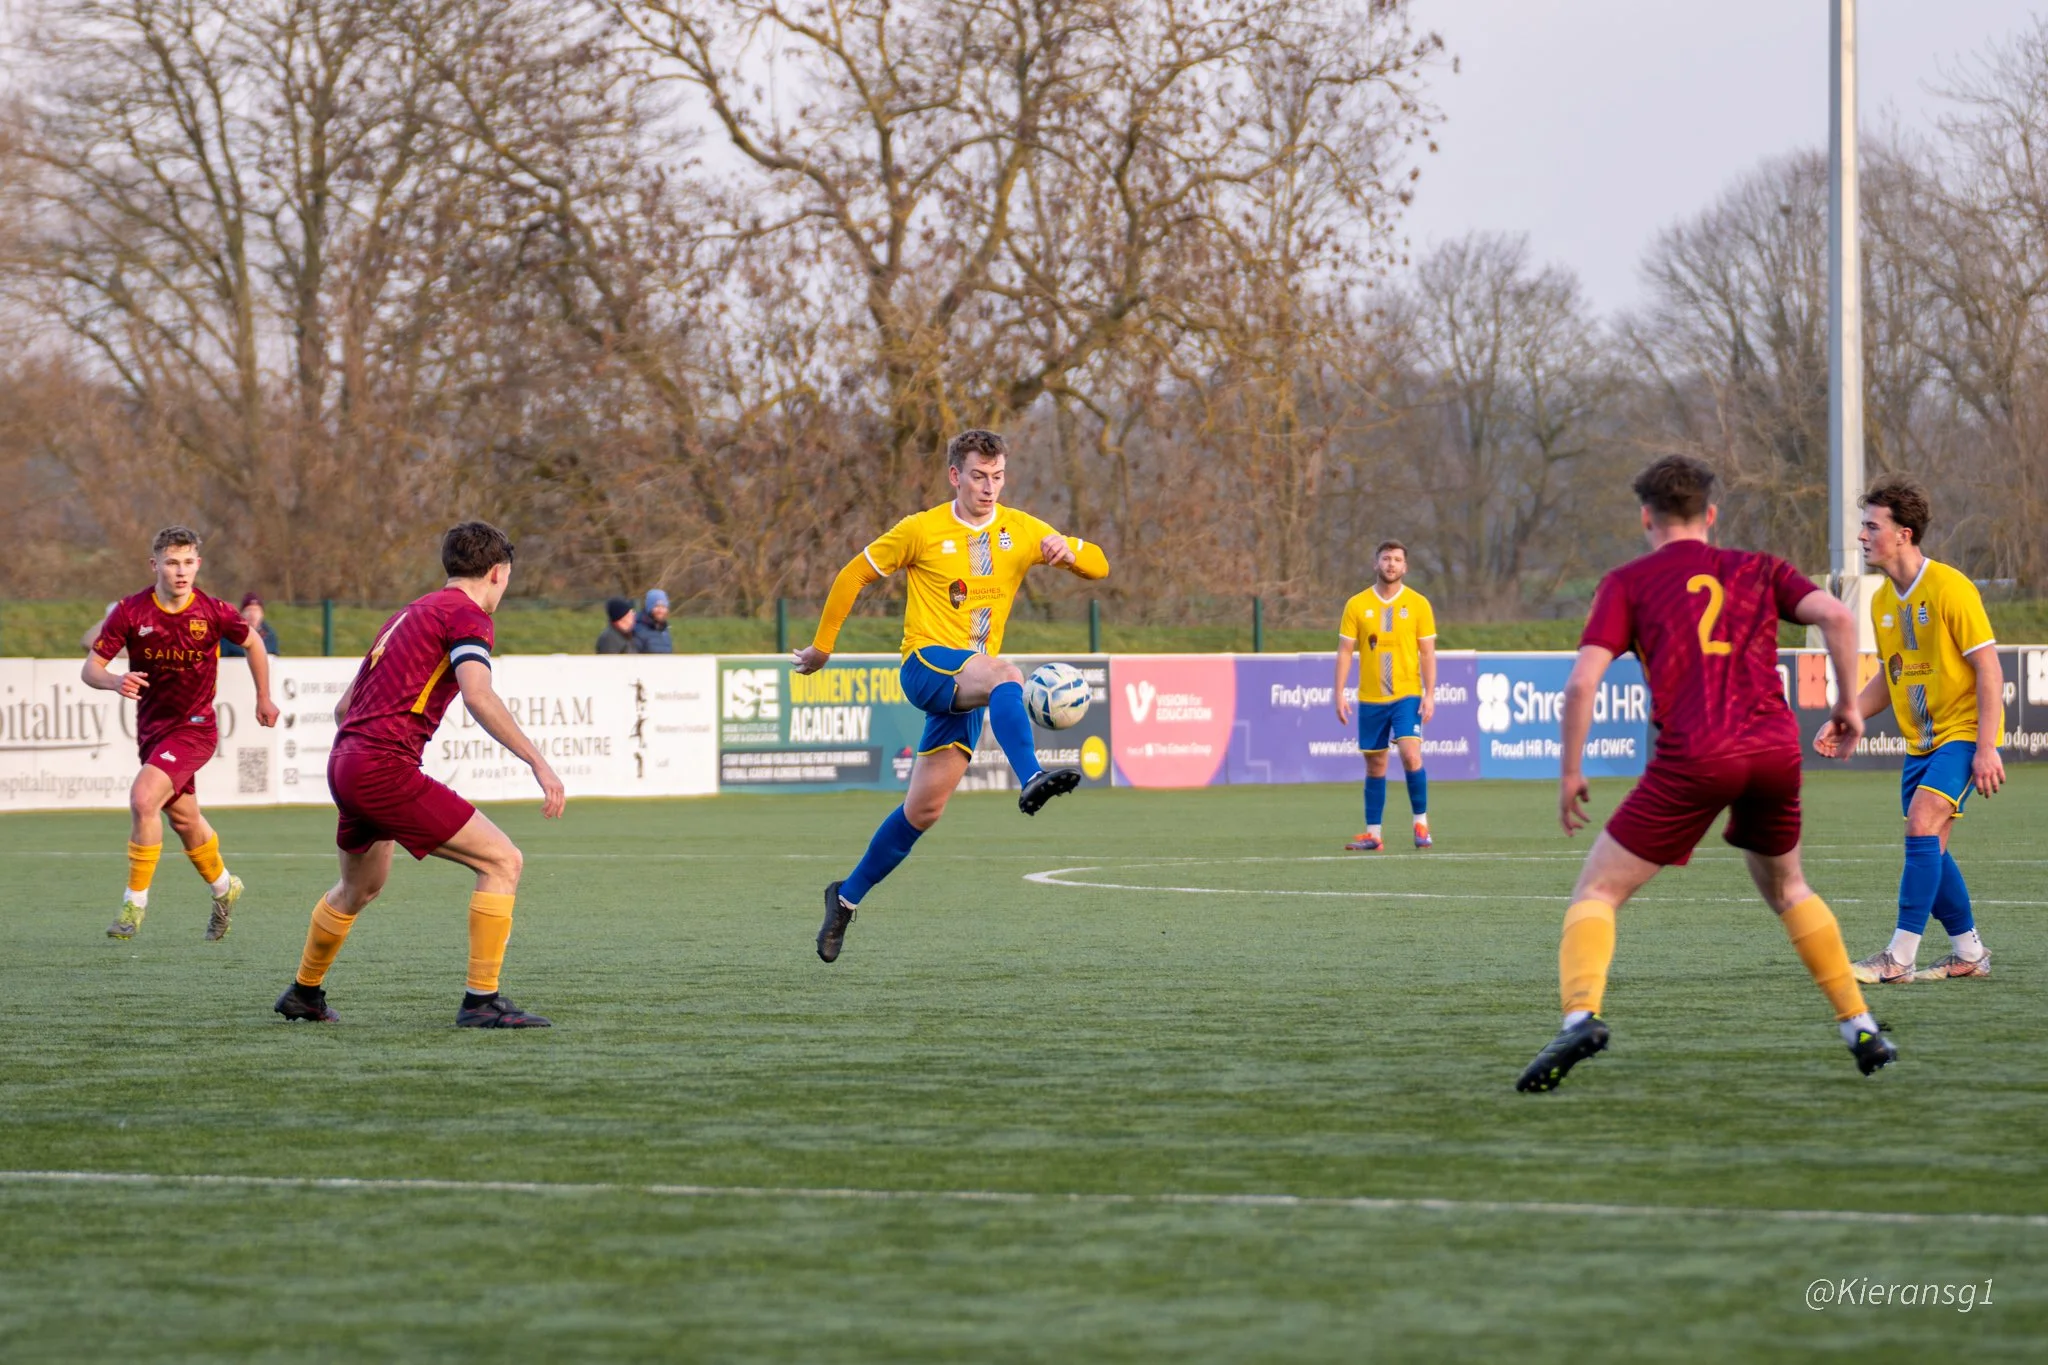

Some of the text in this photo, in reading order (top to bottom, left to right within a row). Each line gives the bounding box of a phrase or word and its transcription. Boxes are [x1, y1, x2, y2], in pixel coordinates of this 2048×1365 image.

[970, 587, 1001, 595] HUGHES
[1686, 573, 1732, 655] 2
[144, 648, 204, 661] SAINTS
[789, 667, 868, 704] WOMEN'S
[1271, 684, 1299, 706] Find
[1302, 686, 1333, 710] your
[1422, 683, 1467, 703] ation
[462, 696, 594, 728] DRHAM
[1513, 681, 1648, 722] Shred HR
[789, 705, 872, 743] ACADEMY
[2013, 725, 2028, 749] do
[442, 739, 493, 761] SIXTH
[552, 736, 611, 757] CENTRE
[1035, 749, 1080, 763] COLLEGE
[1491, 739, 1525, 757] Proud
[1526, 740, 1543, 756] HR
[1586, 739, 1600, 756] of
[1600, 738, 1636, 757] DWFC
